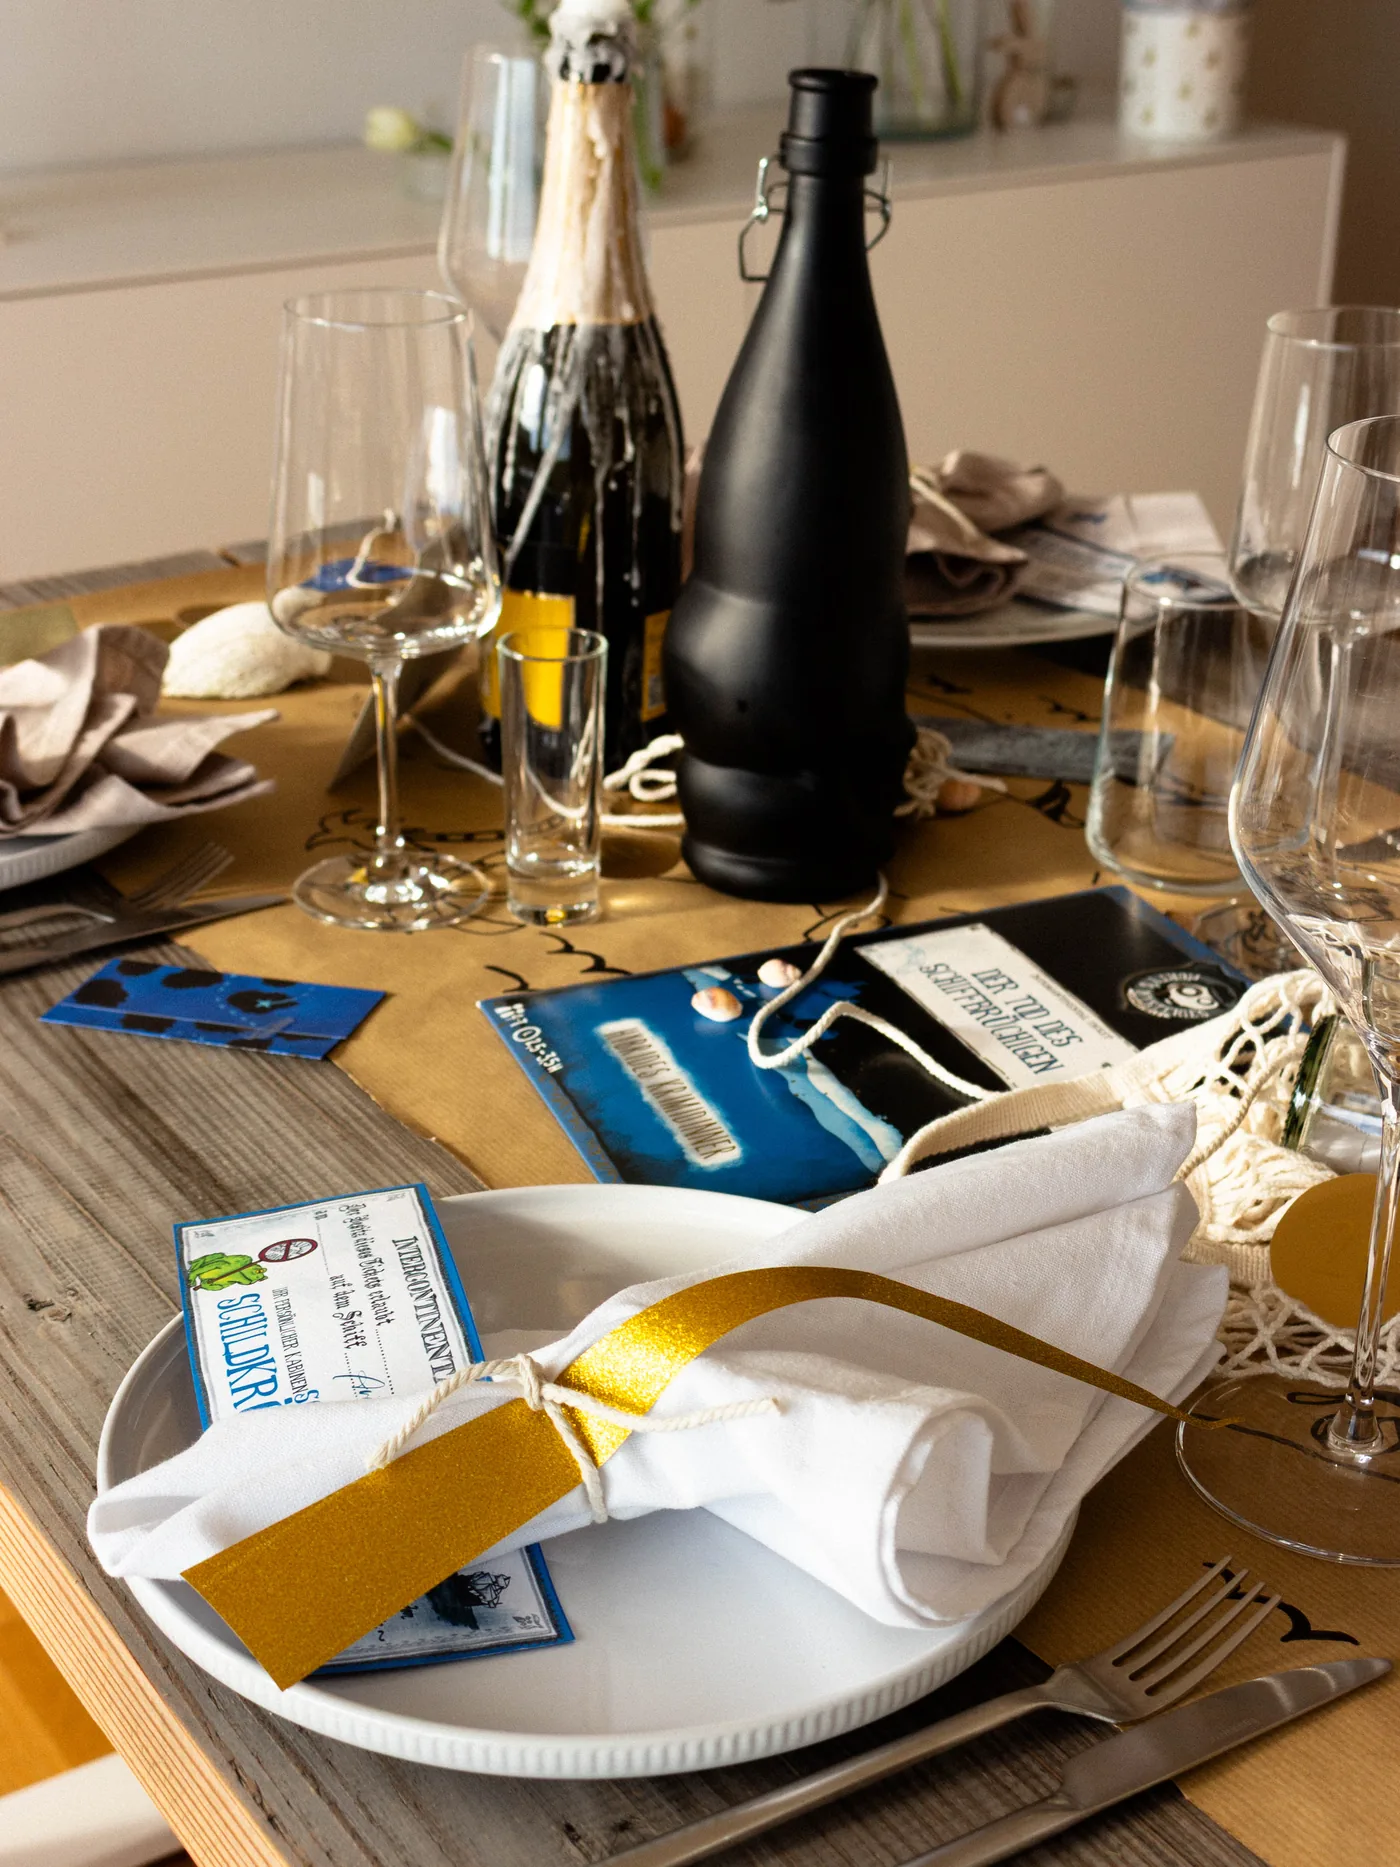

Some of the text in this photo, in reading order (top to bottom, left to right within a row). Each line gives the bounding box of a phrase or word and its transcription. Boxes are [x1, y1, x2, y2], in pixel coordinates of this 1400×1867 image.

[919, 962, 1065, 1075] SCHIFFBRÜCHIGEN
[970, 967, 1019, 995] DER
[1004, 993, 1052, 1021] TOD
[1033, 1019, 1084, 1048] DES
[647, 1078, 737, 1160] KRIMIDINNER
[354, 1237, 375, 1259] dieses
[329, 1274, 353, 1289] auf
[359, 1257, 385, 1289] Tickets
[333, 1289, 355, 1310] dem
[368, 1290, 395, 1326] erlaubt
[392, 1236, 457, 1384] INTERCONTINENT
[274, 1295, 299, 1351] PERSÖNLICHER
[332, 1310, 367, 1349] Schiff
